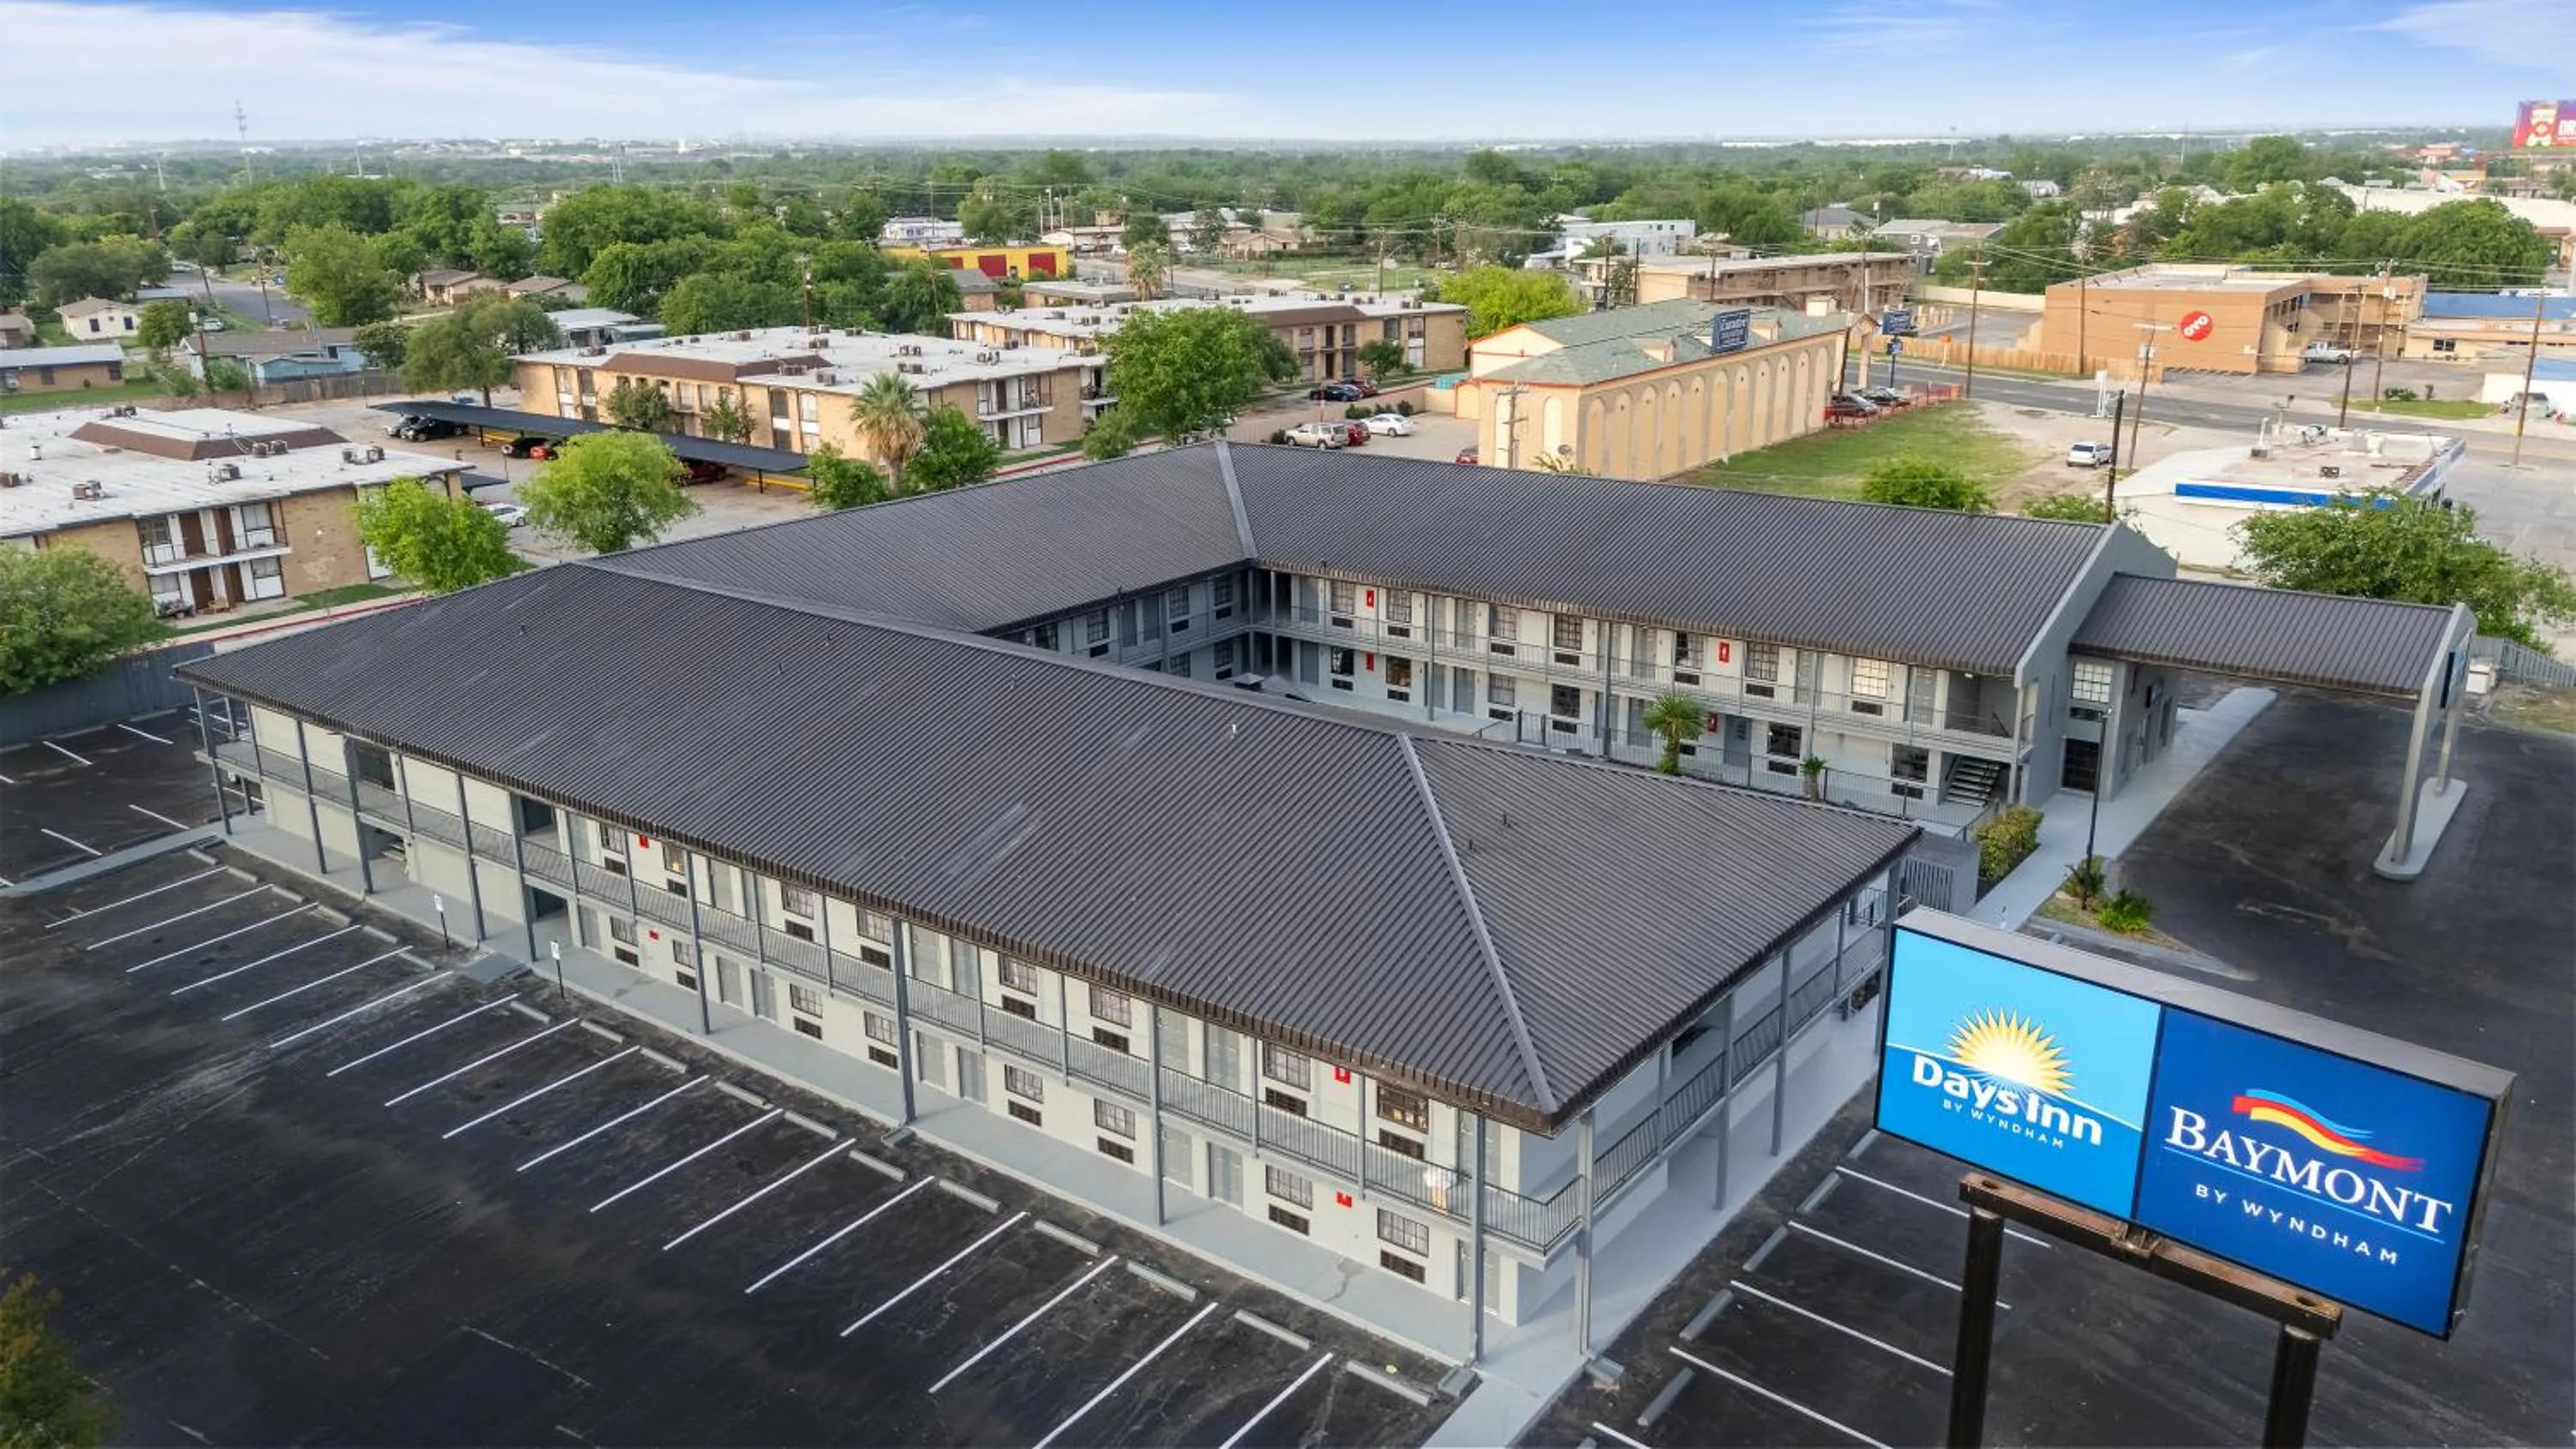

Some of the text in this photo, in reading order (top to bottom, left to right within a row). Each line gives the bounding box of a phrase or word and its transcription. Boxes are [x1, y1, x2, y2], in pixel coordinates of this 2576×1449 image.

[2184, 315, 2209, 337] OYO
[1912, 1053, 2103, 1147] Days Inn
[1942, 1098, 2064, 1149] BY WYNDHAM
[2165, 1106, 2452, 1234] BAYMONT
[2195, 1183, 2397, 1265] BY WYNDHAM
